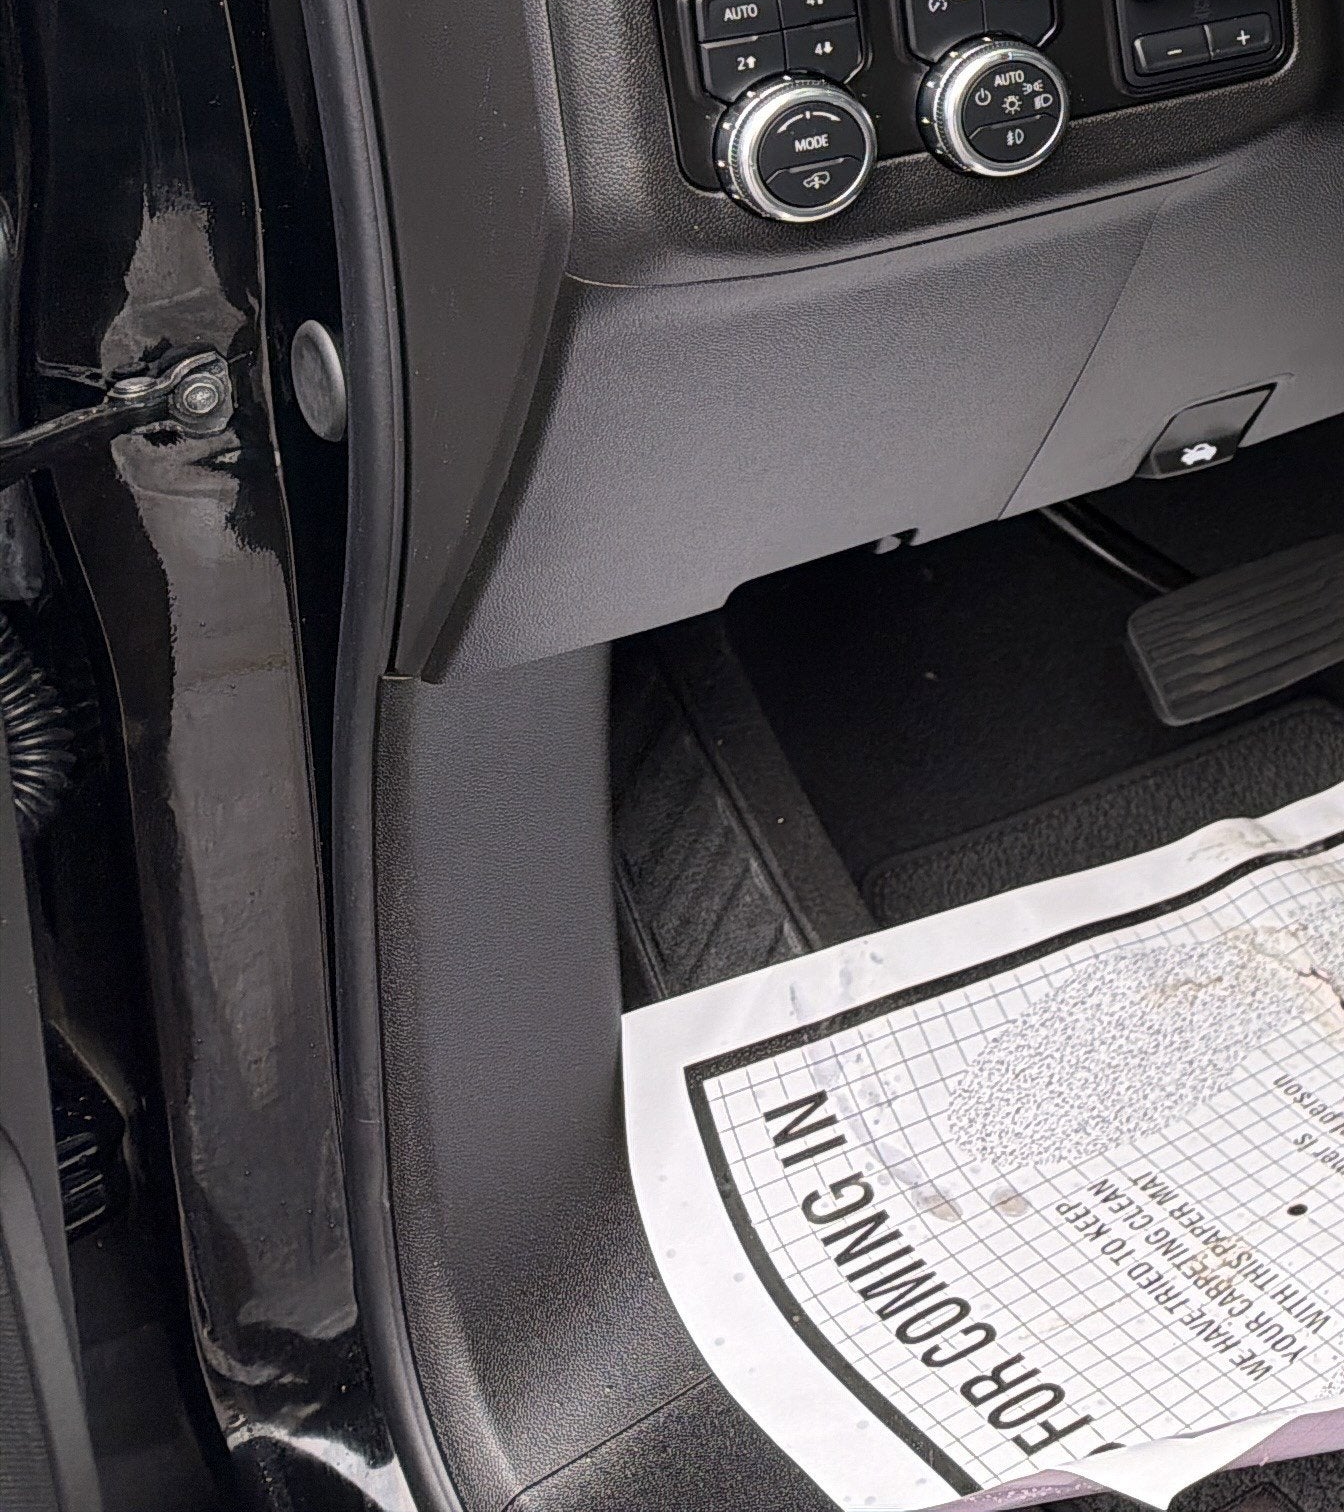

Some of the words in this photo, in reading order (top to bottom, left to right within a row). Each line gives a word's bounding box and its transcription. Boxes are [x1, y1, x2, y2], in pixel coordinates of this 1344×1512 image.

[723, 3, 758, 22] AUTO
[994, 69, 1025, 87] AUTO
[795, 134, 829, 152] MODE
[1273, 1073, 1344, 1125] person
[763, 1089, 848, 1168] IN
[1293, 1132, 1318, 1152] is
[1087, 1178, 1154, 1231] CLEAN
[1130, 1170, 1180, 1207] MAT
[1055, 1201, 1112, 1242] KEEP
[1168, 1201, 1238, 1258] PAPER
[800, 1171, 998, 1368] COMING
[1100, 1238, 1136, 1266] TO
[1145, 1227, 1253, 1318] CARPETING
[1226, 1249, 1280, 1292] THIS
[1127, 1261, 1190, 1315] TRIED
[1269, 1284, 1331, 1335] WITH
[1179, 1310, 1241, 1355] HAVE
[1244, 1311, 1308, 1364] YOUR
[1228, 1348, 1273, 1381] WE
[959, 1352, 1095, 1456] FOR
